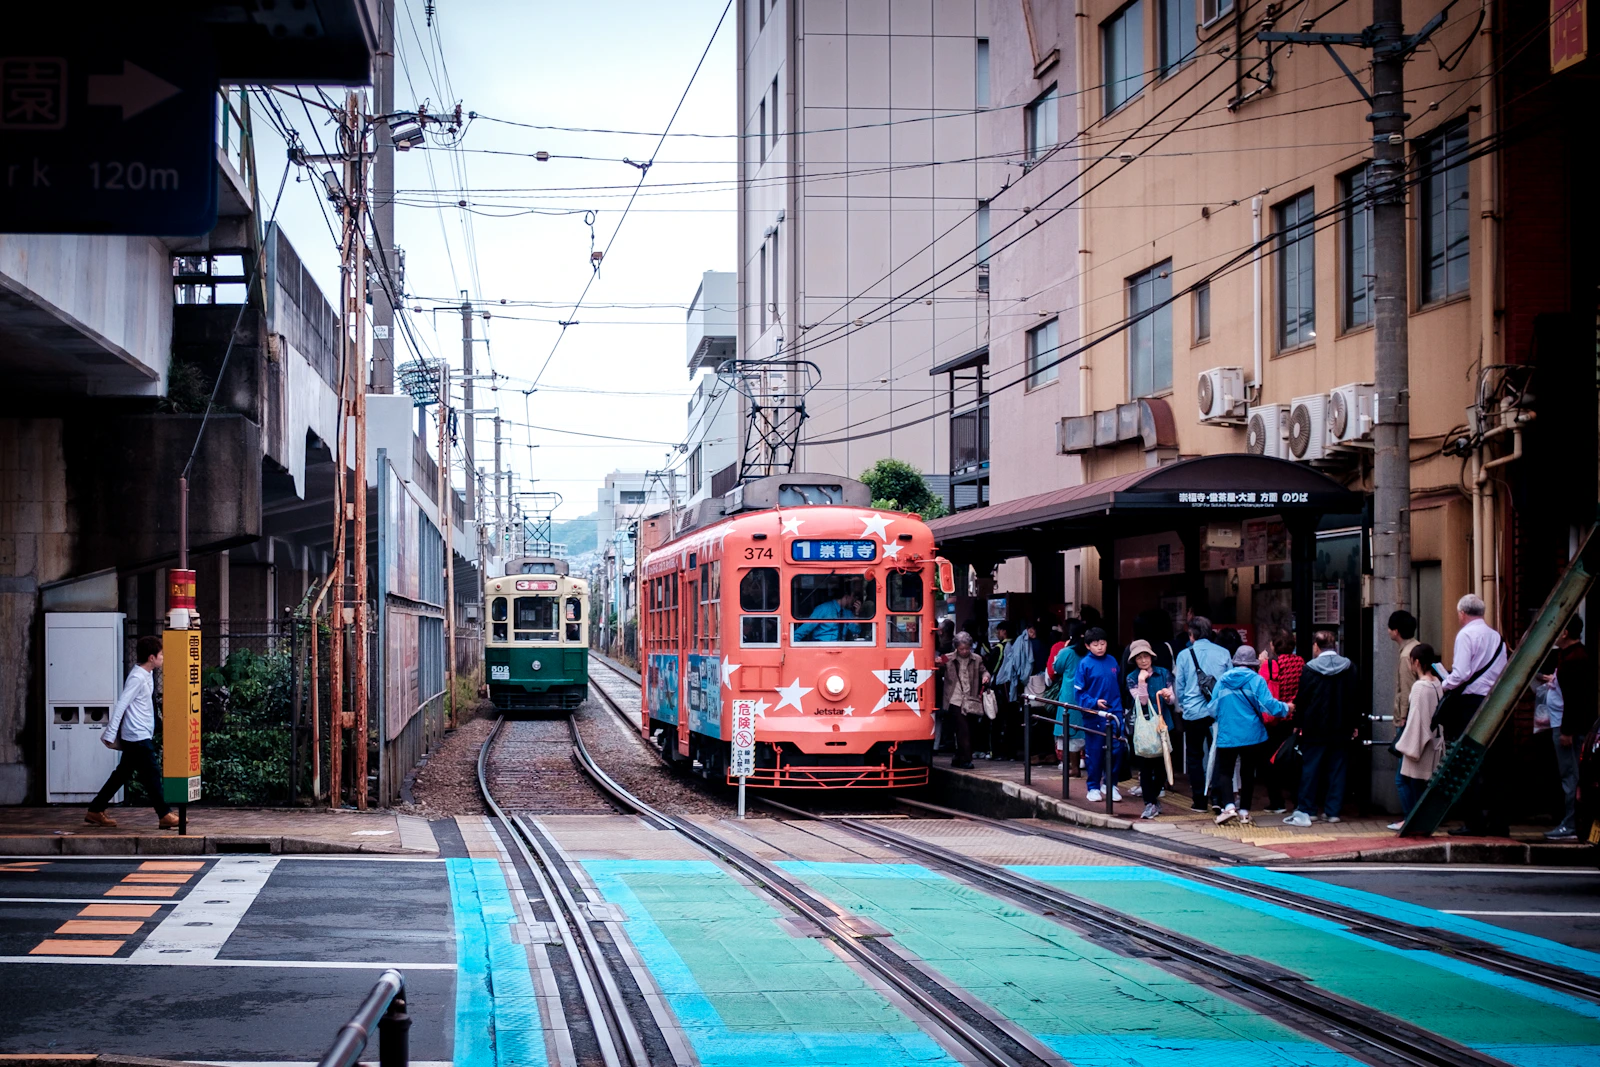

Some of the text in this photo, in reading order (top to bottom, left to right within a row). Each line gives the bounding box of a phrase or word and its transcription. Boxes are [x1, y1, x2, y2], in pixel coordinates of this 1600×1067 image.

[89, 161, 179, 190] 120m
[1260, 492, 1278, 503] 方面
[1282, 492, 1308, 503] のりば
[744, 547, 774, 560] 374
[796, 541, 872, 559] 1 崇福寺
[517, 580, 529, 590] 3
[491, 665, 510, 673] 502
[888, 668, 918, 684] 長崎
[888, 687, 924, 703] 就航!
[189, 635, 200, 772] 電車に注意
[738, 703, 751, 729] 危険
[814, 708, 844, 716] Jetstar
